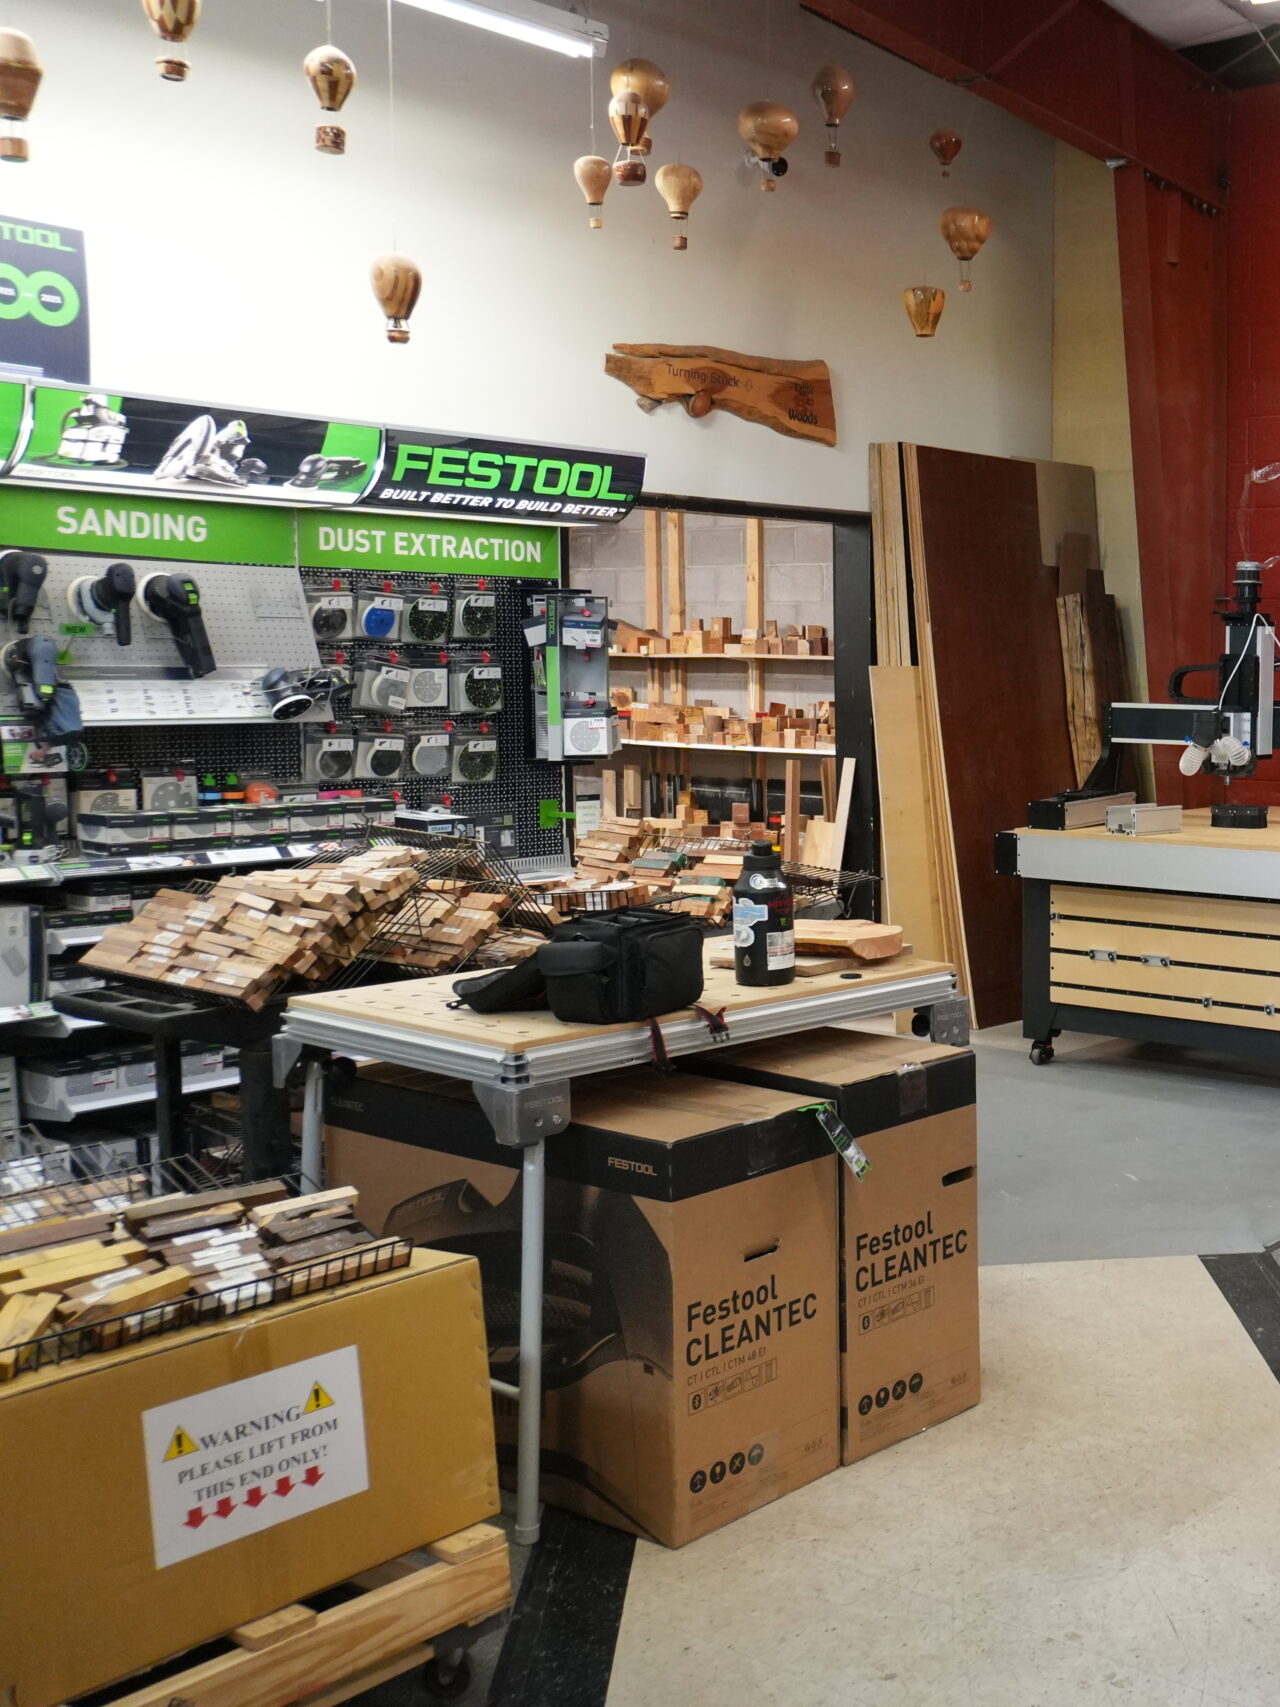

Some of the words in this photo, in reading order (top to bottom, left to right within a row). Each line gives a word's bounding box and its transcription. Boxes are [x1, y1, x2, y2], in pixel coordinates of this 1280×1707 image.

[666, 363, 707, 383] Turning
[710, 371, 740, 388] Stock
[788, 408, 818, 425] Woods
[392, 443, 627, 502] FESTOOL
[379, 488, 432, 502] BUILT
[430, 491, 492, 508] BETTER
[495, 498, 514, 509] TO
[515, 500, 562, 513] BUILD
[56, 506, 208, 543] SANDING
[318, 526, 387, 554] DUST
[394, 532, 541, 563] EXTRACTION
[65, 625, 87, 634] NEW
[607, 1156, 658, 1176] FESTOOL
[856, 1210, 933, 1262] Festool
[855, 1229, 968, 1292] CLEANTEC
[687, 1274, 778, 1332] Festool
[686, 1293, 817, 1366] CLEANTEC
[705, 1366, 720, 1379] CTL
[728, 1355, 745, 1370] CTM
[199, 1405, 303, 1450] WARNING
[177, 1448, 244, 1485] PLEASE
[249, 1435, 286, 1461] LIFT
[290, 1418, 338, 1446] FROM
[193, 1478, 235, 1503] THIS
[240, 1464, 274, 1488] END
[278, 1445, 328, 1473] ONLY!
